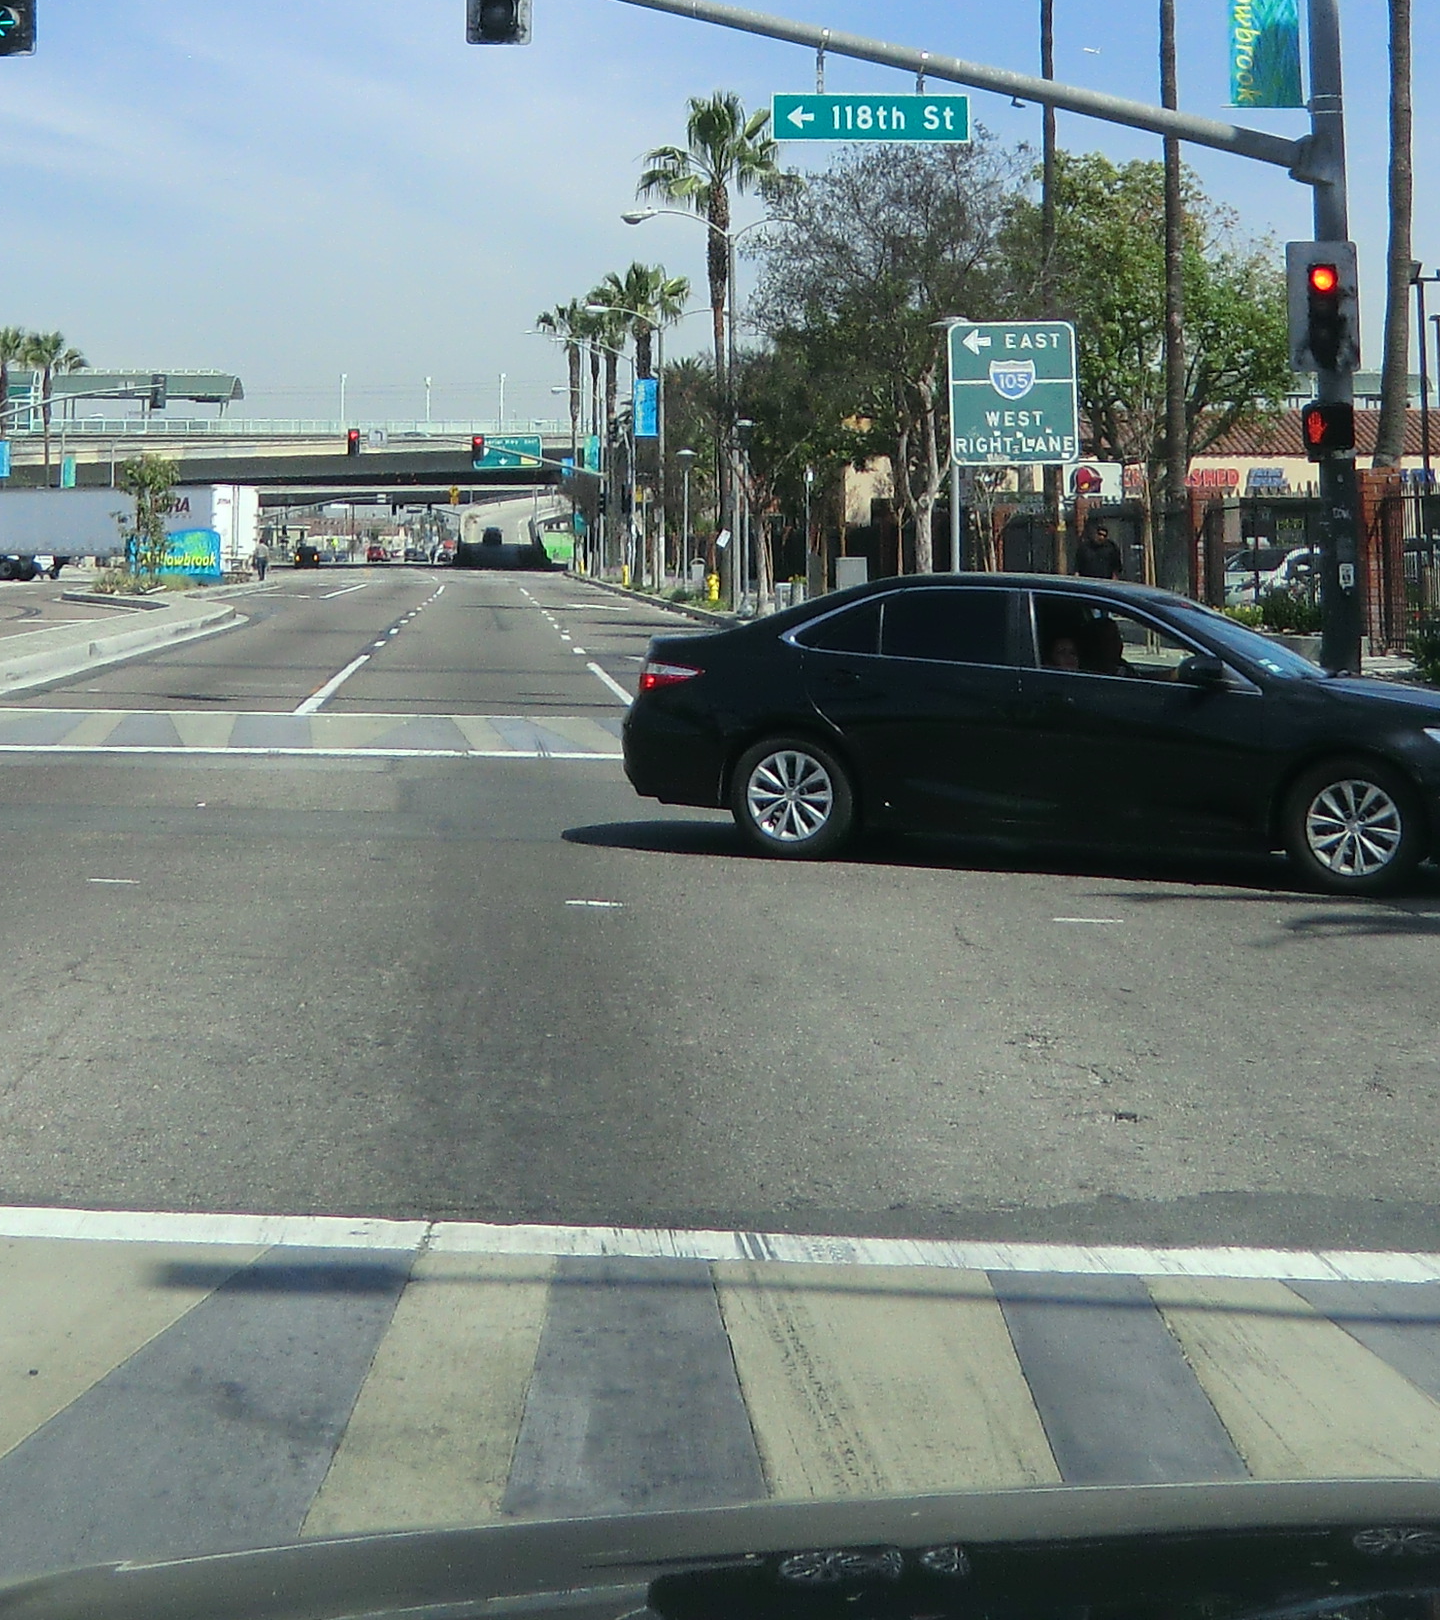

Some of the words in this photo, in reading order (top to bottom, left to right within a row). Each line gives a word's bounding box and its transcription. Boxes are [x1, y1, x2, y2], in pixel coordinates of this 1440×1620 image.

[832, 105, 905, 130] 118th
[923, 105, 954, 130] St
[1005, 333, 1060, 349] EAST
[999, 373, 1028, 389] 105
[986, 411, 1043, 427] WEST
[955, 437, 1013, 453] RIGHT
[1021, 436, 1074, 453] LANE
[1185, 468, 1240, 487] SHED
